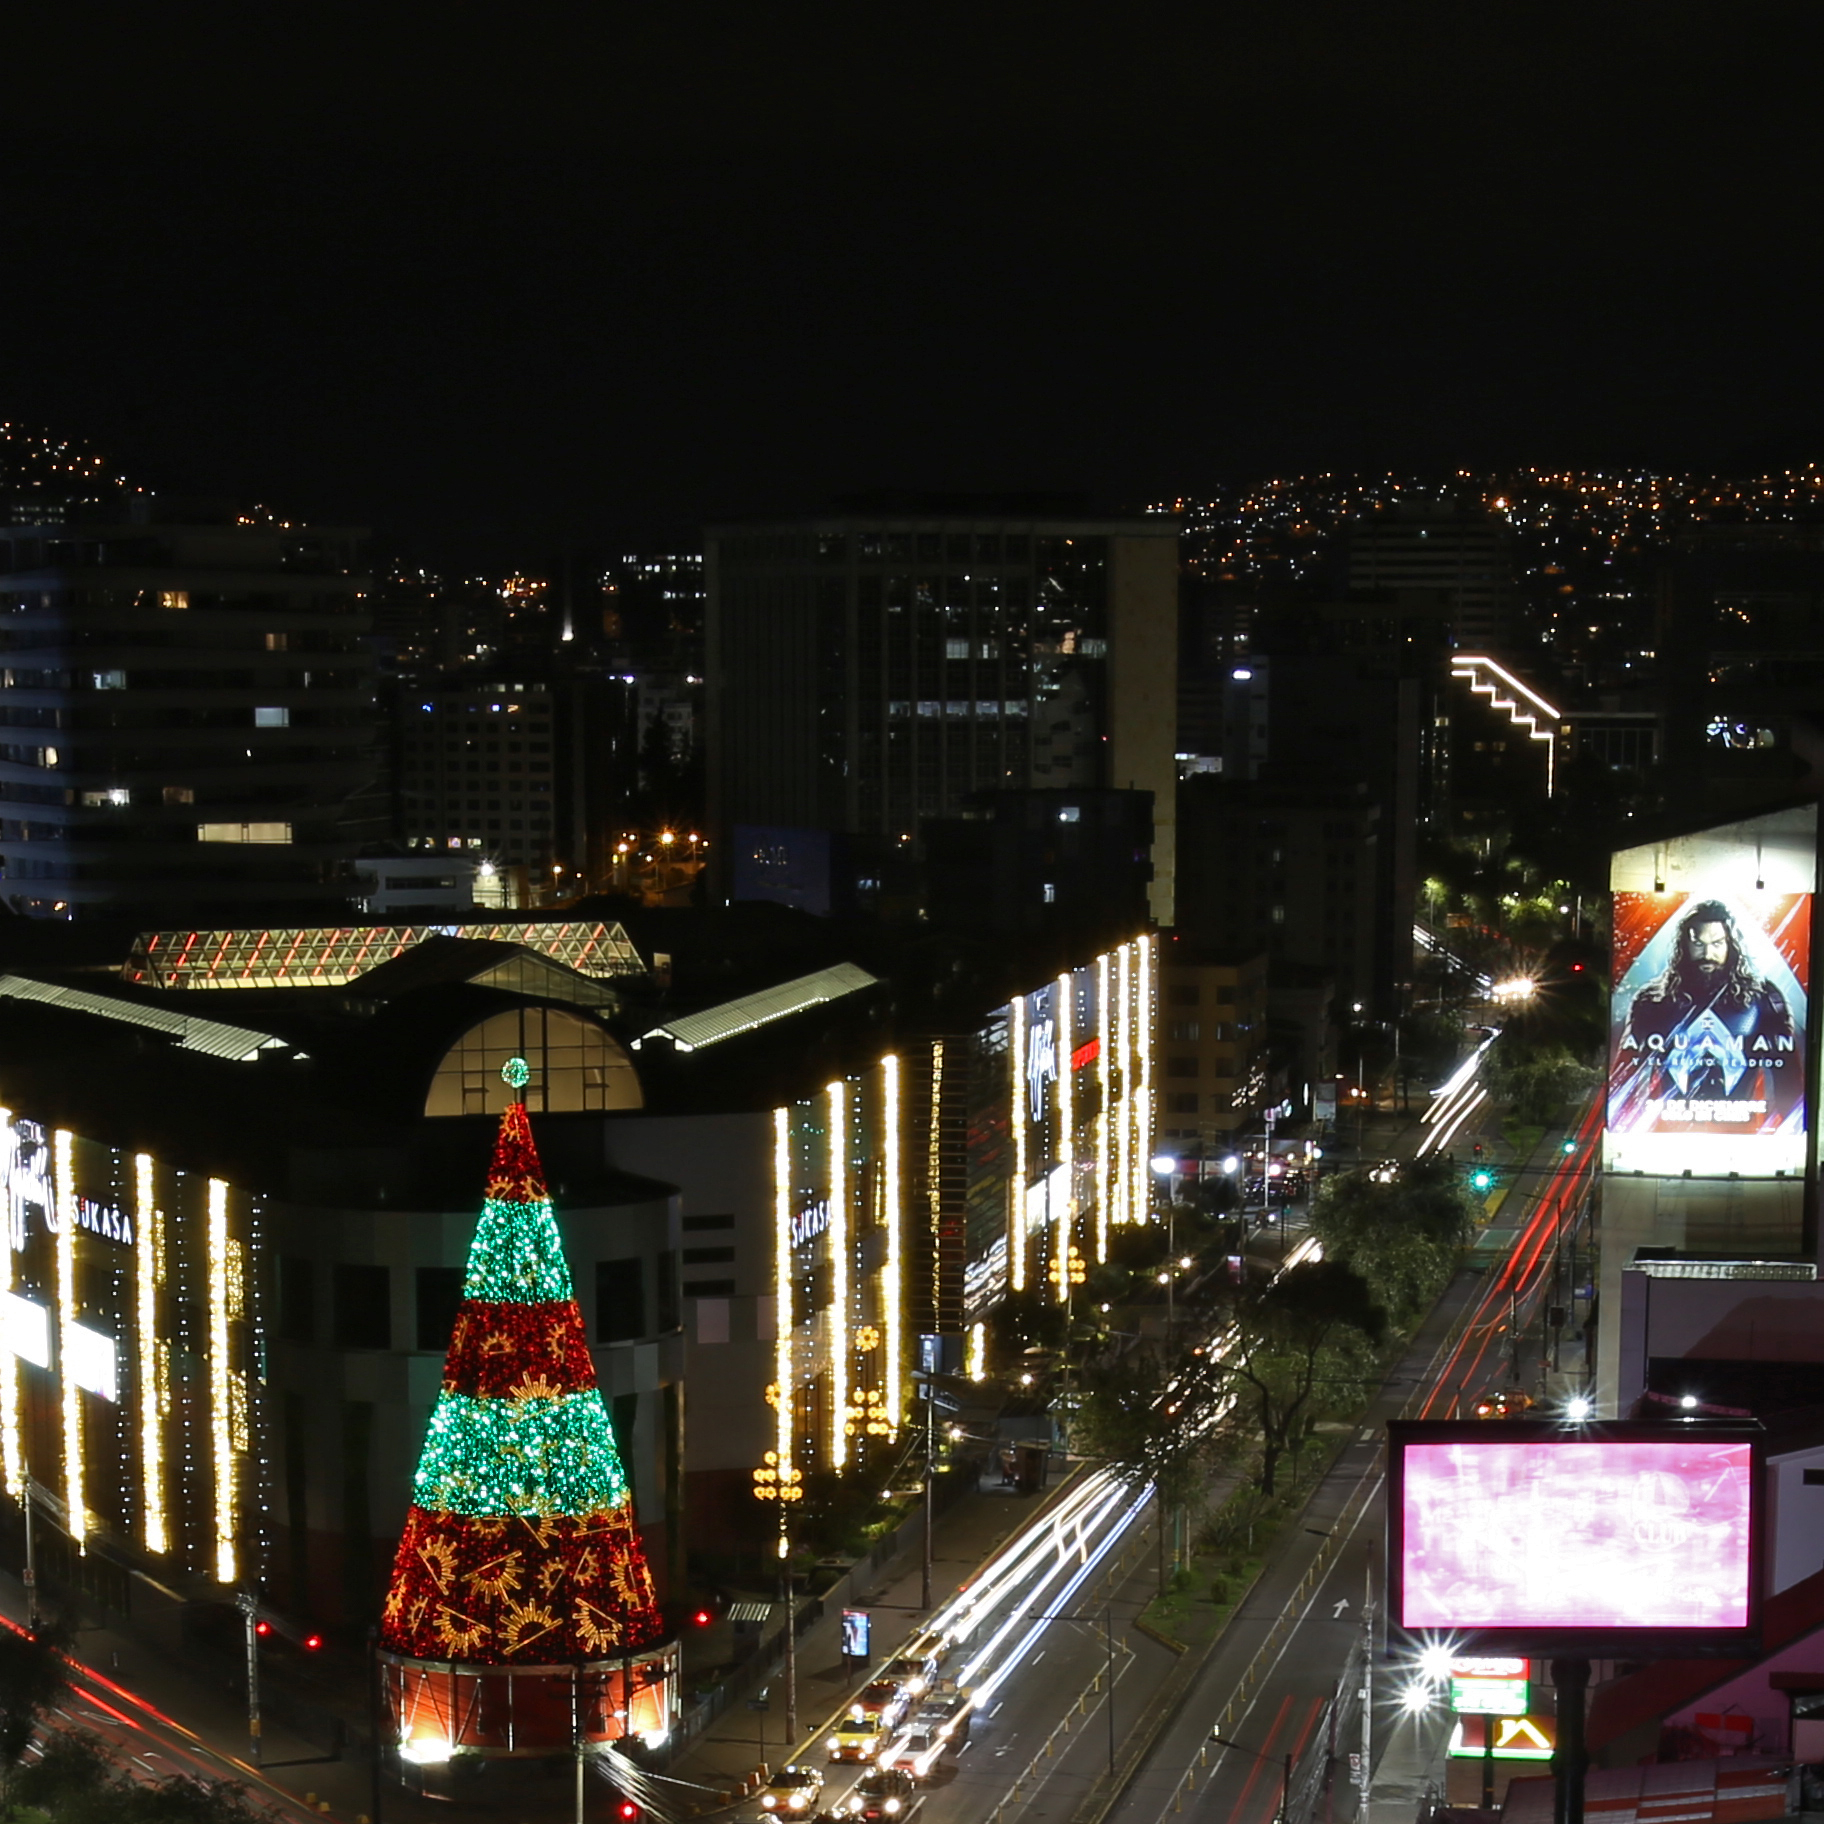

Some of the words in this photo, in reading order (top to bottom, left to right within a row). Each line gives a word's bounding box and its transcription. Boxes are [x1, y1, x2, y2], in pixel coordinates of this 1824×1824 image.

[1622, 1034, 1795, 1053] AQUAMAN
[1632, 1057, 1640, 1066] Y
[1648, 1058, 1662, 1066] EL
